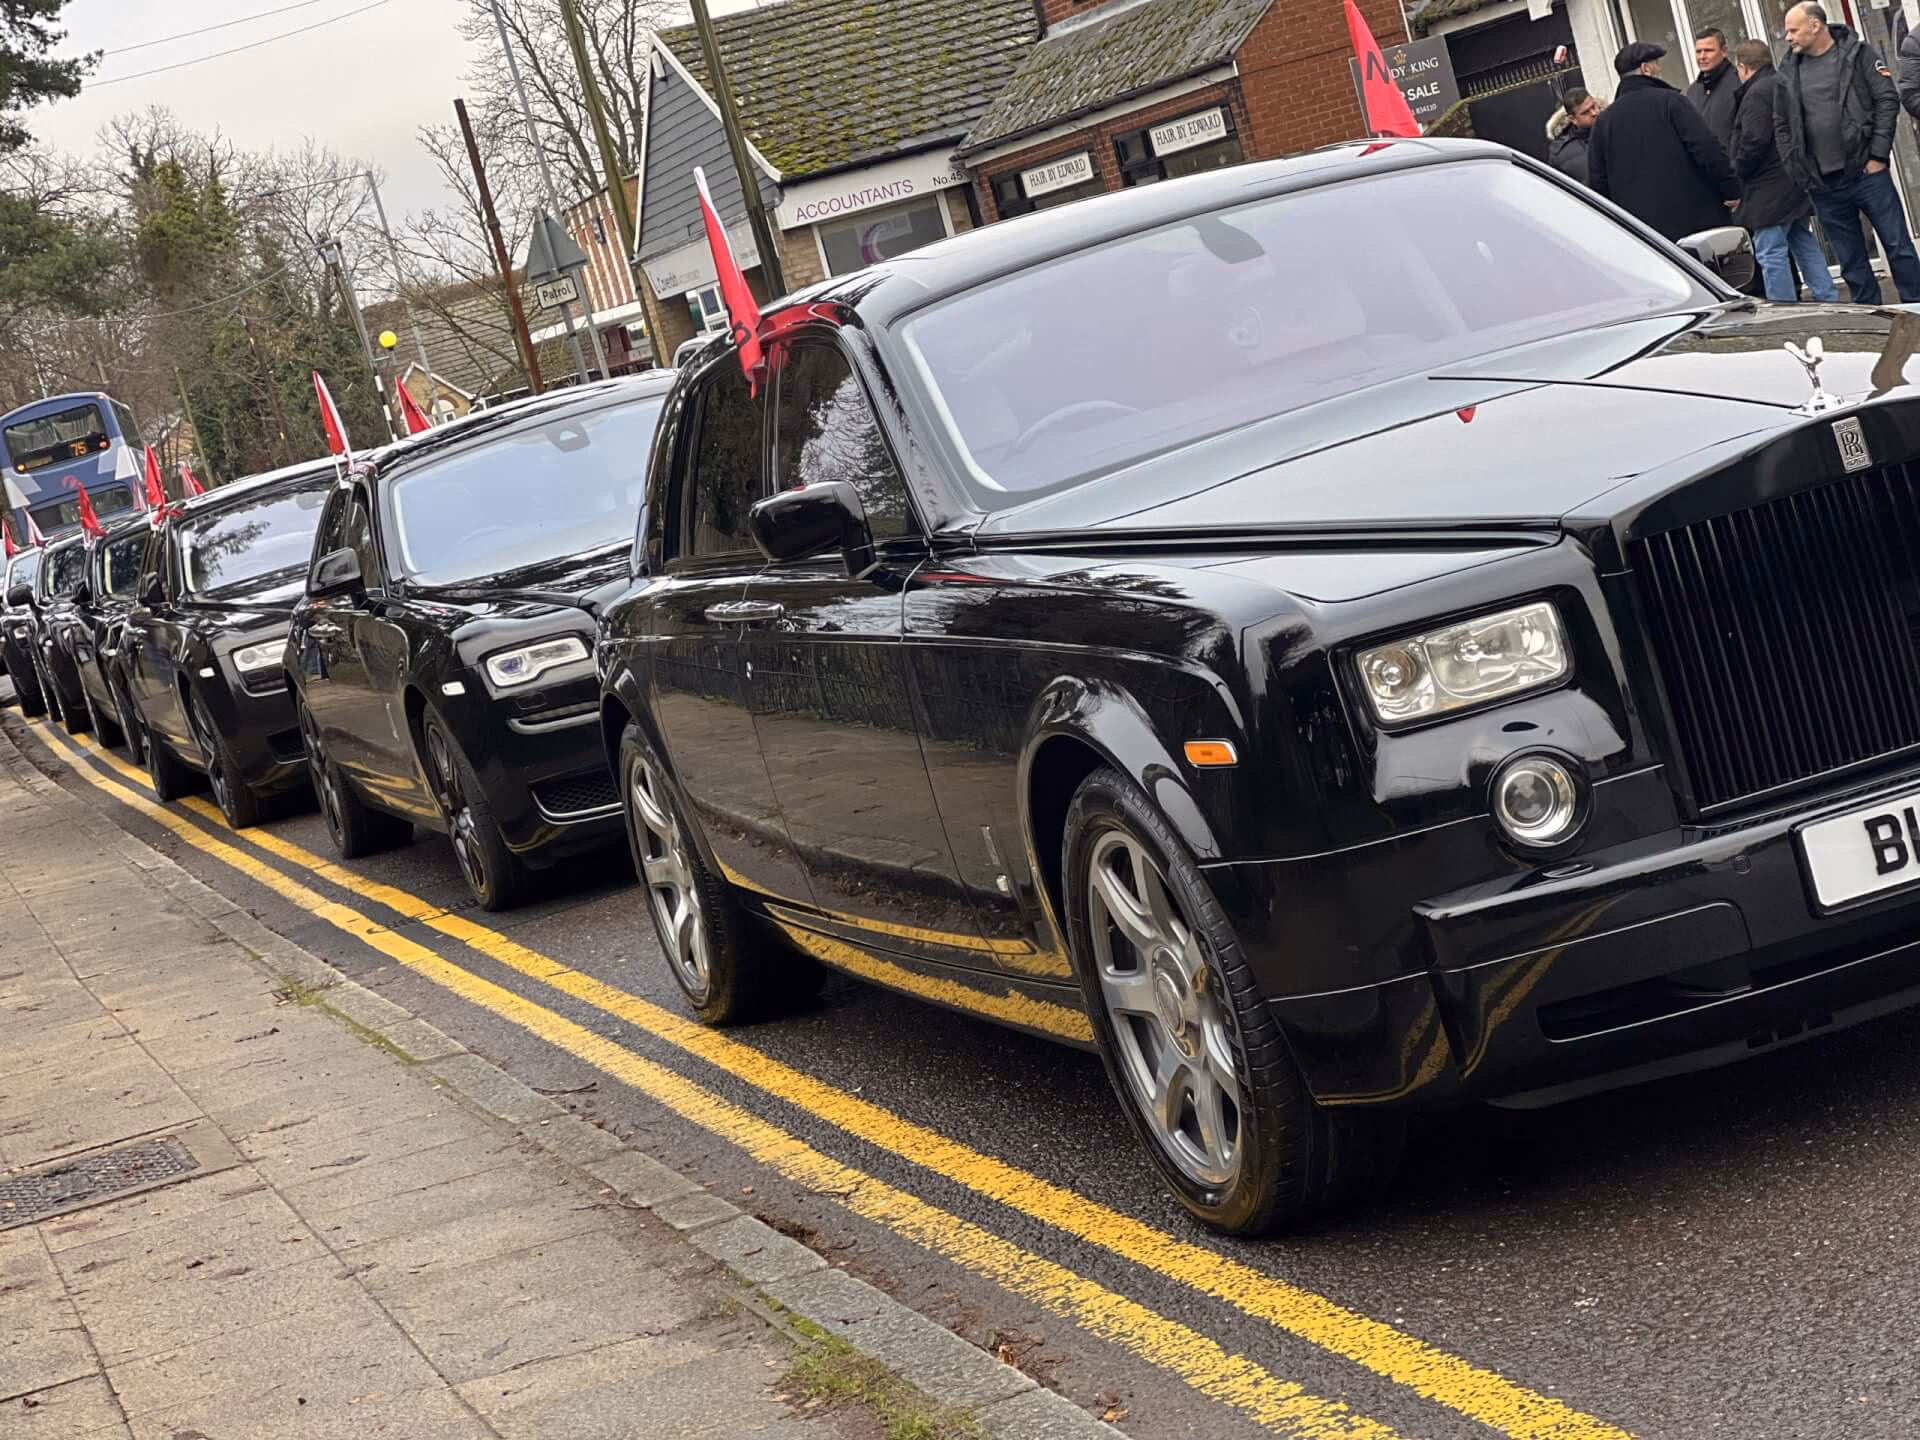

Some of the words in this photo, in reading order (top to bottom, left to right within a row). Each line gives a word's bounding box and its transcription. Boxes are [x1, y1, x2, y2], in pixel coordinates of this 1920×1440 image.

[1410, 57, 1439, 73] KING
[1407, 82, 1440, 101] SALE
[1154, 127, 1177, 146] HAIR
[1176, 124, 1188, 139] BY
[1187, 113, 1221, 136] EDWARD
[1028, 170, 1048, 187] HAIR
[1047, 167, 1057, 182] BY
[1056, 158, 1086, 178] EDWARD
[796, 179, 914, 222] ACCOUNTANTS
[542, 284, 572, 301] Patrol
[69, 441, 87, 457] 75
